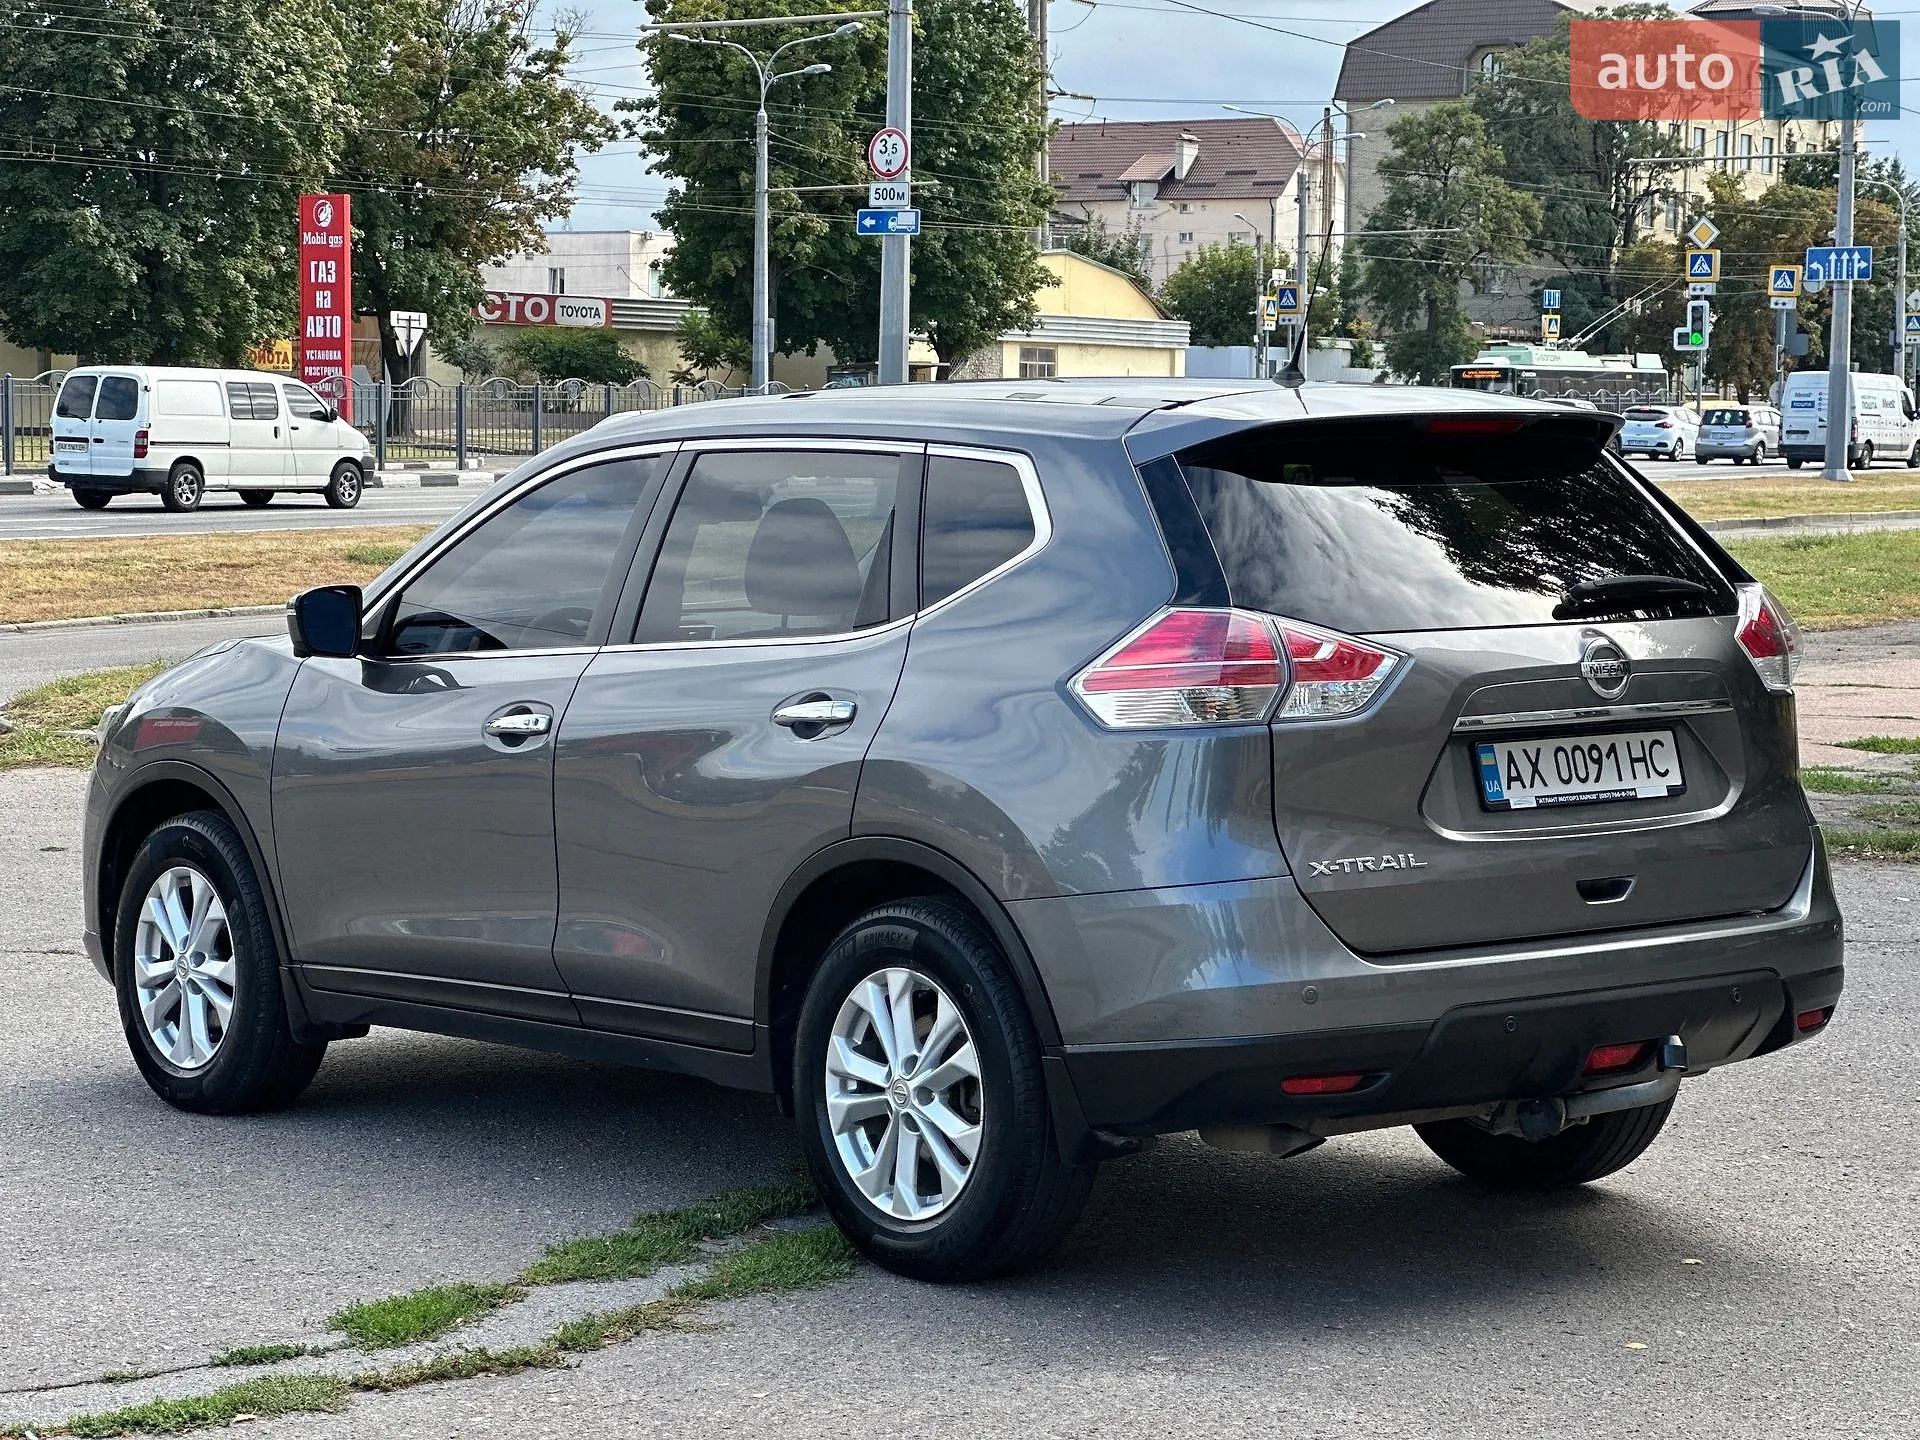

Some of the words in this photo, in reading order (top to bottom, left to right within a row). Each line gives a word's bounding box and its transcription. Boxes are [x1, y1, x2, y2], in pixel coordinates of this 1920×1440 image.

[302, 231, 327, 245] Mobil
[328, 235, 343, 247] gas
[310, 260, 336, 283] ГАЗ
[478, 293, 549, 323] СТО
[560, 305, 601, 319] TOYOTA
[306, 315, 341, 338] АВТО
[305, 349, 342, 361] УСТАНОВКА
[1506, 747, 1548, 790] AX
[1553, 743, 1623, 785] 0091
[1626, 738, 1670, 780] HC
[1486, 780, 1501, 792] UA
[1308, 853, 1428, 878] X-TRAIL
[863, 931, 903, 945] PRIMACY
